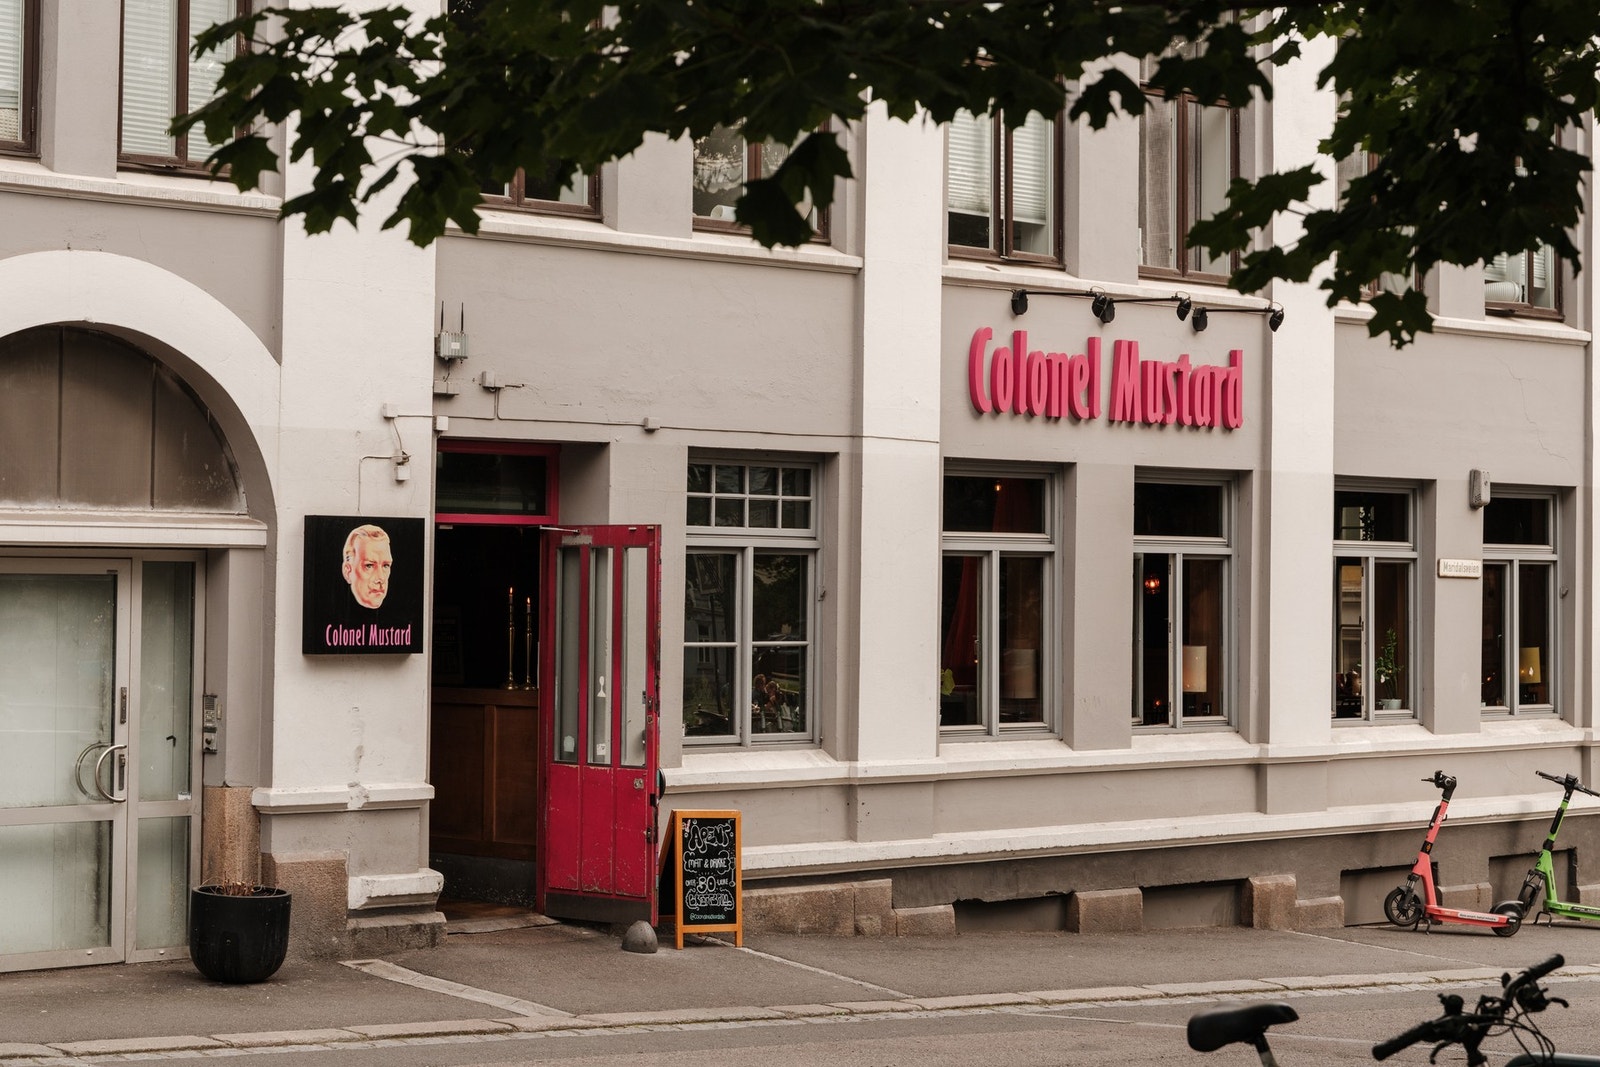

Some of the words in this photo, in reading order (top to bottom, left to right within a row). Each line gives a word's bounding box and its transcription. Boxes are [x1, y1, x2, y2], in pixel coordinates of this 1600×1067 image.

[968, 327, 1102, 420] Colonel
[1108, 339, 1244, 429] Mustard
[326, 624, 365, 646] Colonel
[369, 624, 411, 646] Mustard
[688, 859, 703, 868] MAT
[704, 859, 709, 868] &
